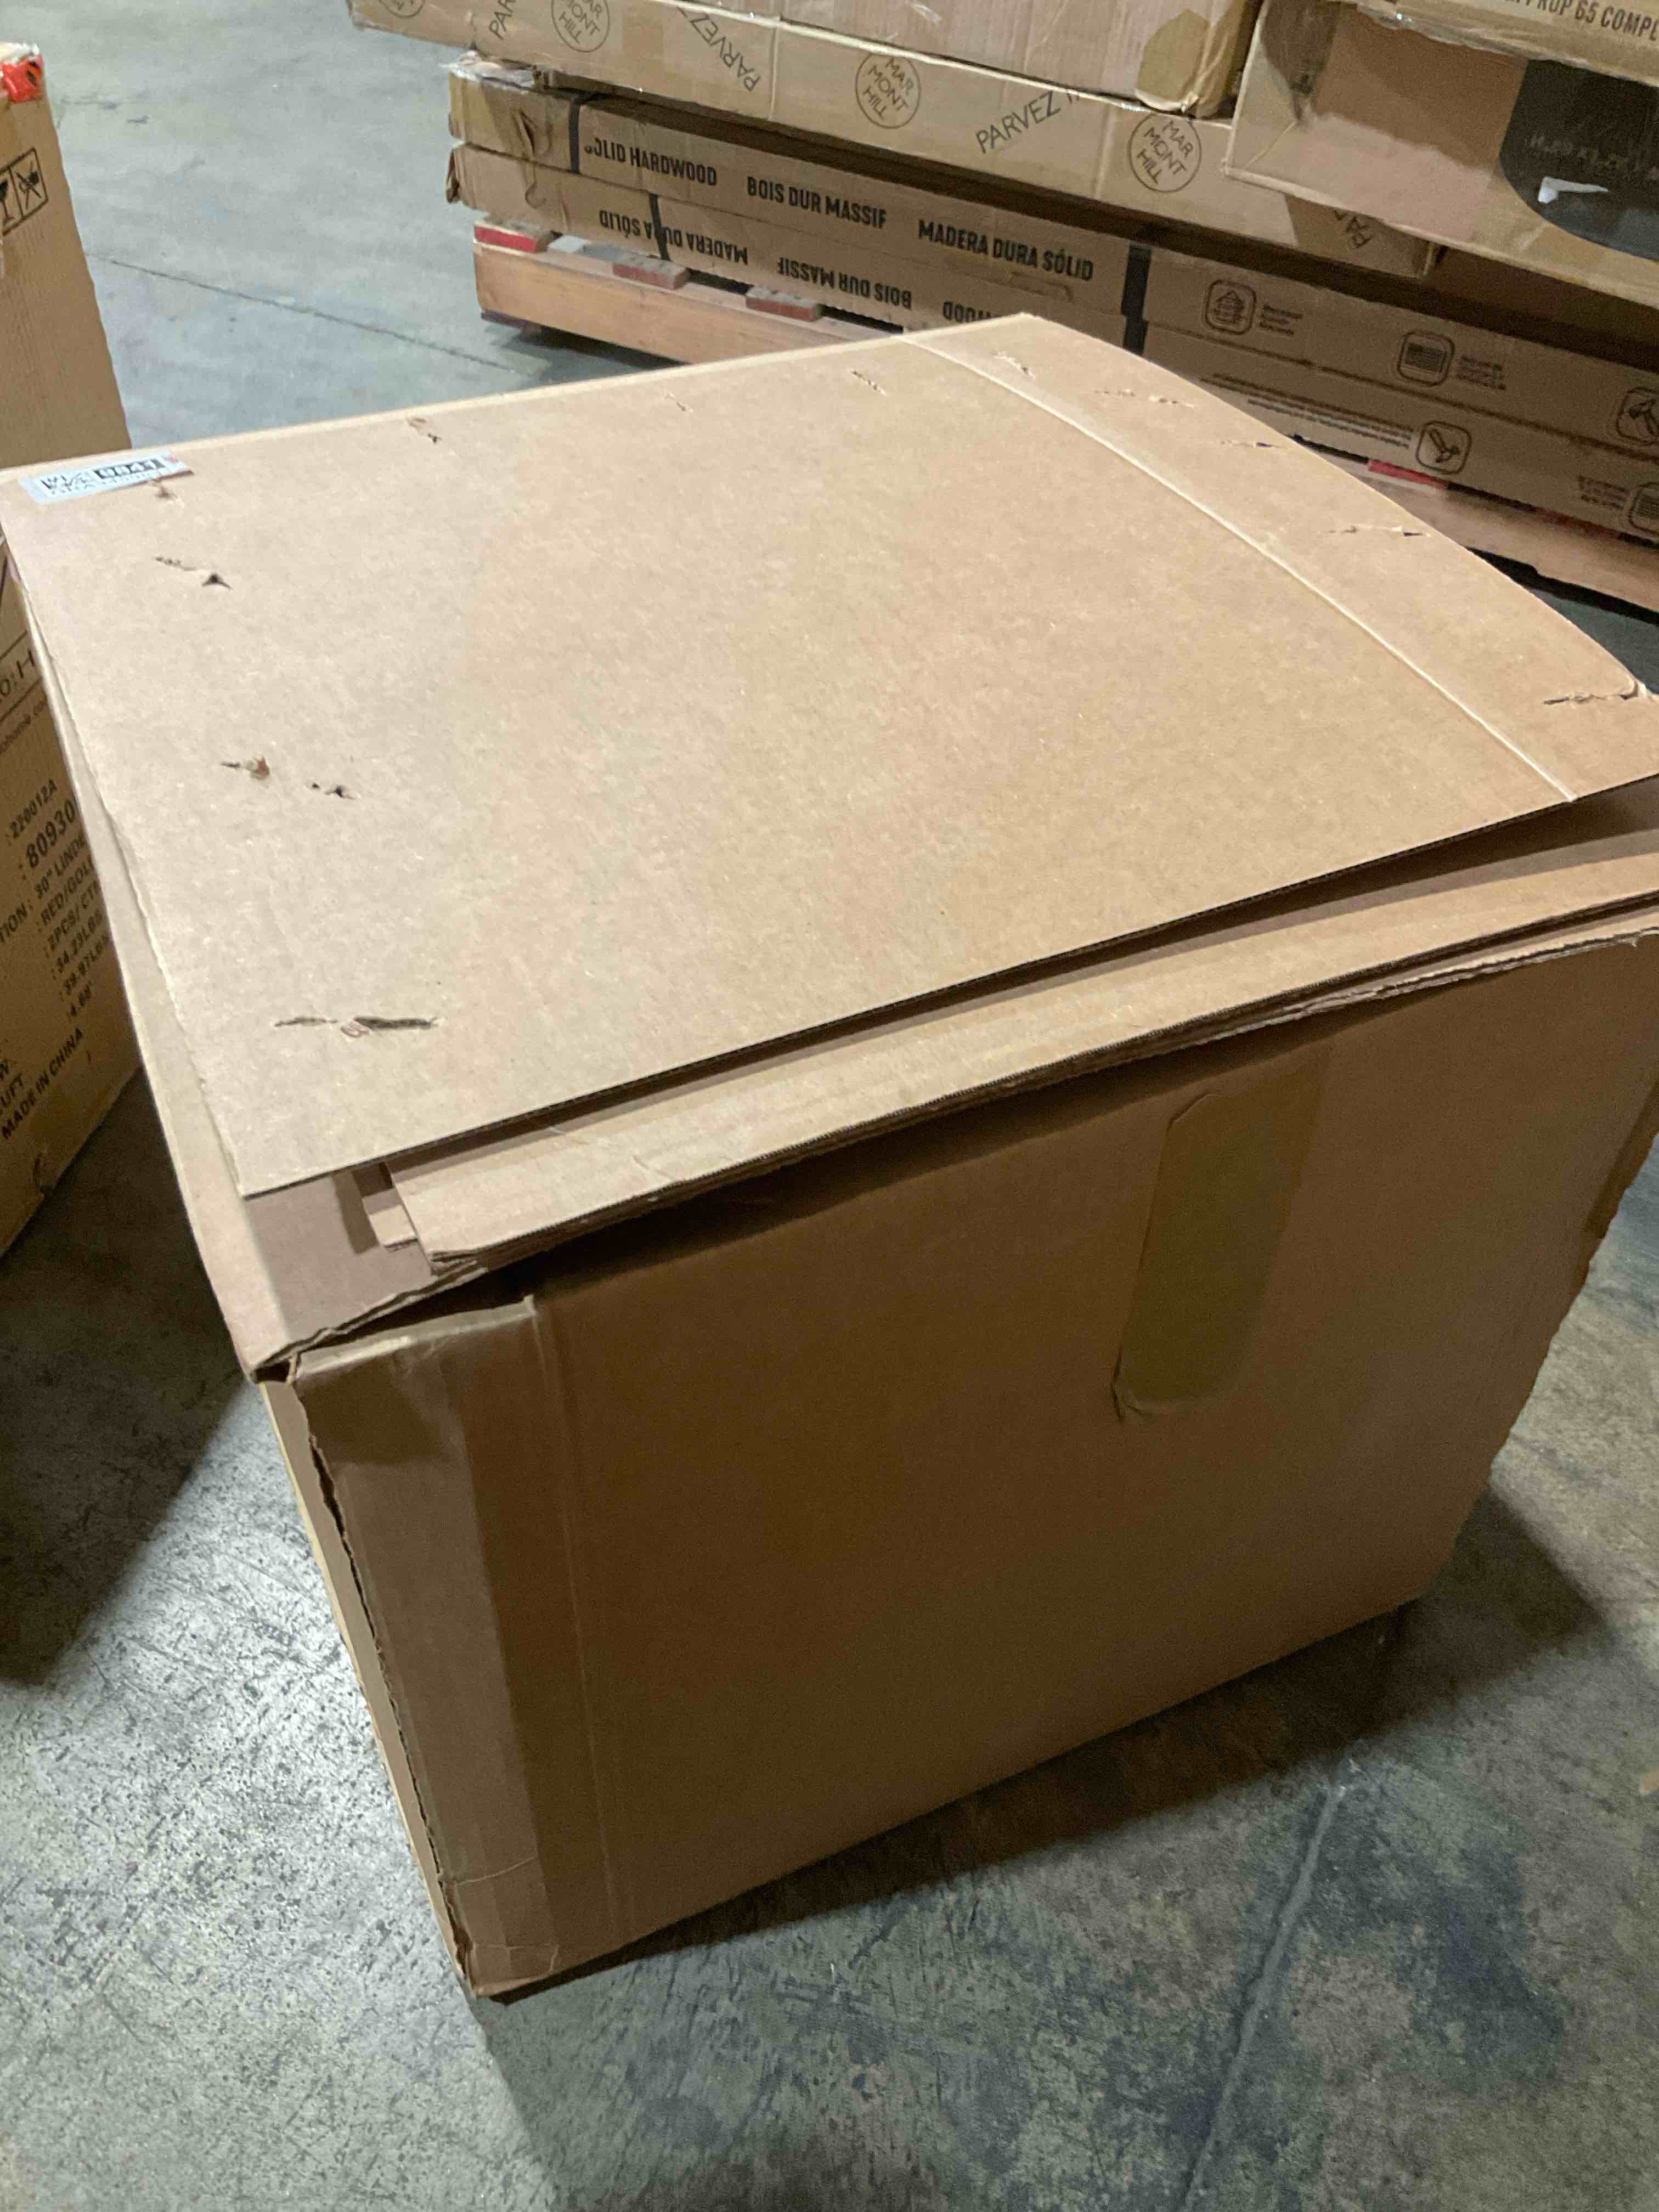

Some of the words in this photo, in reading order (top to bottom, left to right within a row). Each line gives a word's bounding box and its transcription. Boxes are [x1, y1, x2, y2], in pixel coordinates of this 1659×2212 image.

[1575, 0, 1599, 23] 65
[868, 65, 909, 111] MONT
[975, 90, 1062, 154] PARVEZ
[1161, 120, 1194, 159] MAR
[1143, 127, 1187, 176] MONT
[599, 209, 641, 239] SÓLID
[629, 146, 718, 186] HARDWOOD
[747, 176, 785, 204] BOIS
[788, 186, 821, 214] DUR
[825, 195, 887, 229] MASSIF
[918, 219, 988, 255] MADERA
[992, 238, 1038, 269] DURA
[1041, 249, 1094, 281] SÓLID
[686, 232, 748, 266] MADERA
[777, 257, 836, 289] MASSIF
[838, 272, 871, 299] DUR
[873, 282, 913, 311] BOIS
[2, 1089, 35, 1139] MADE
[35, 1071, 49, 1094] IN
[49, 1026, 83, 1076] CHINA
